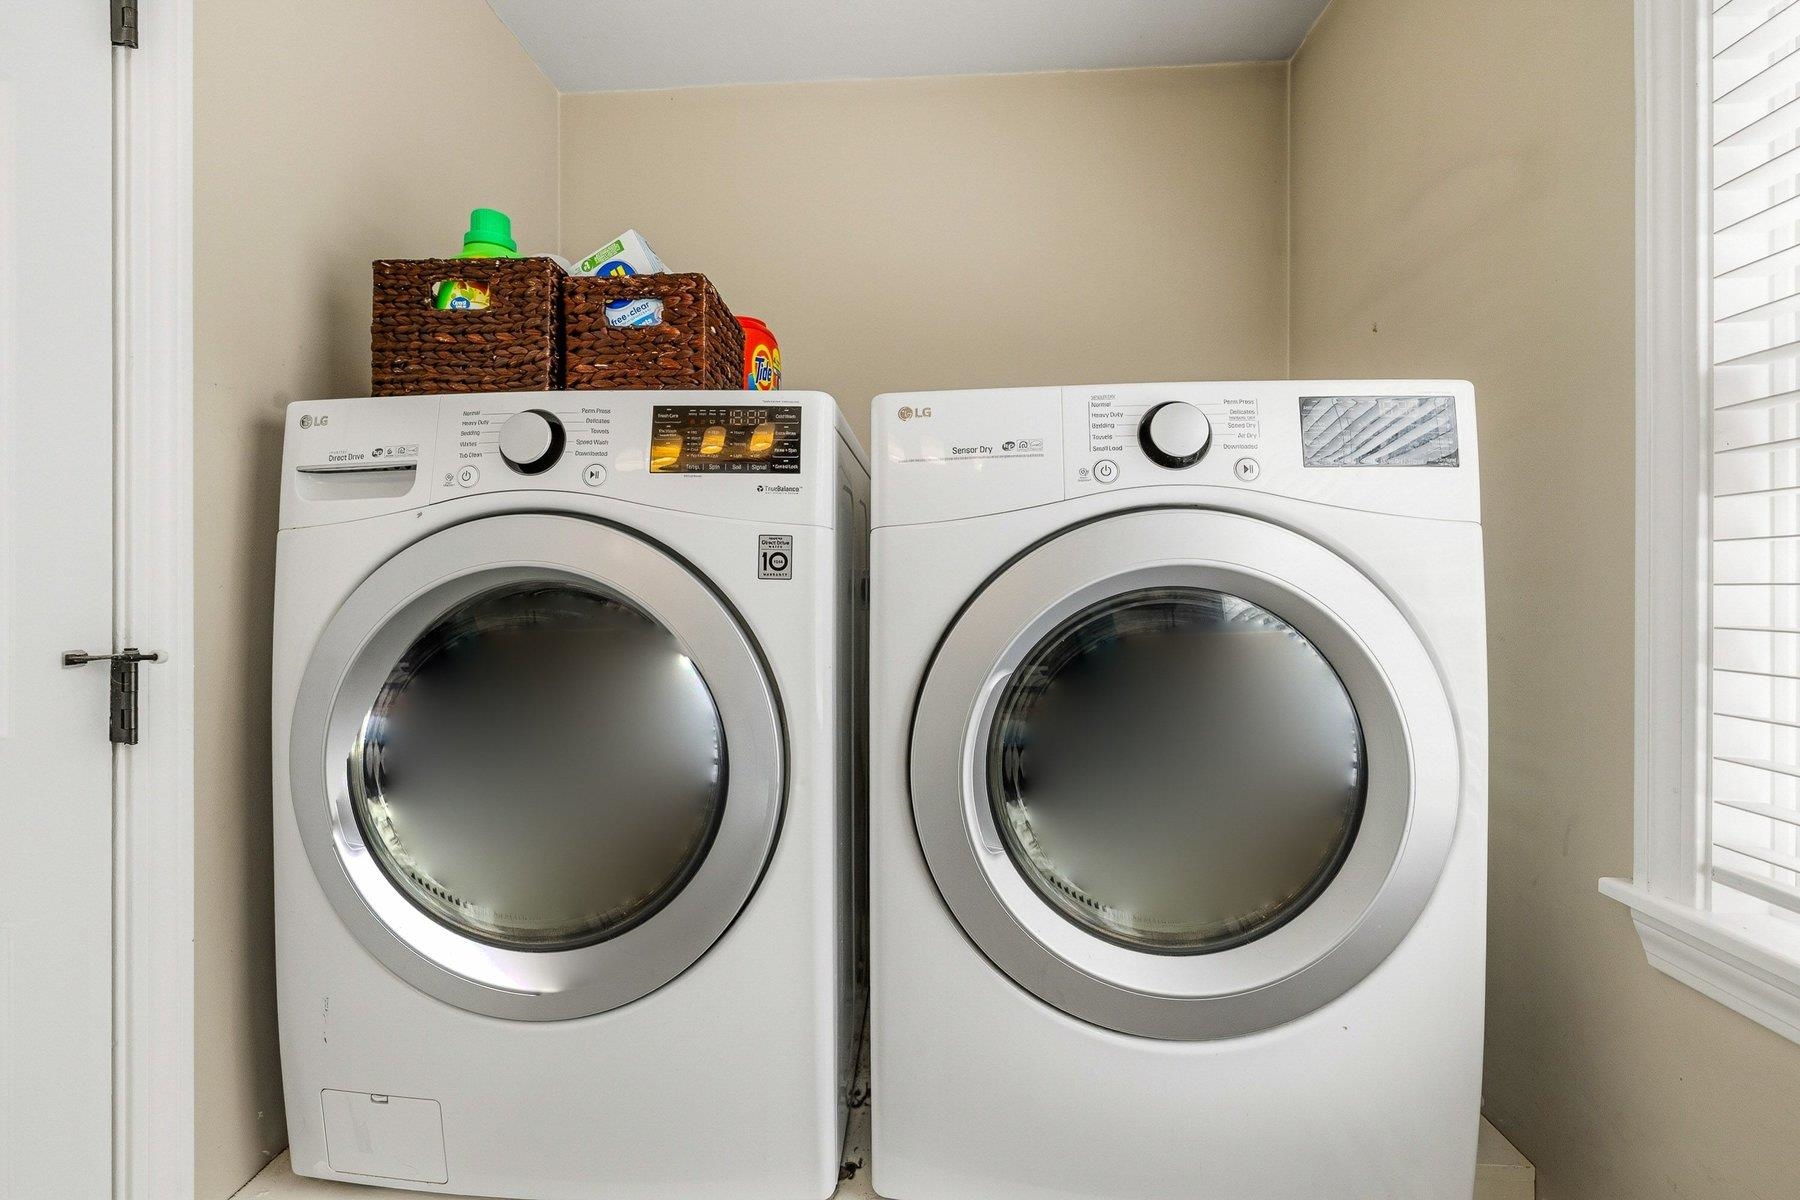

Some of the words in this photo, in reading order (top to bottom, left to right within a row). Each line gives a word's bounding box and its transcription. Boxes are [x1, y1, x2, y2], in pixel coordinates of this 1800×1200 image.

[611, 314, 627, 327] free
[630, 302, 650, 316] clear
[755, 357, 772, 383] Tide
[328, 454, 347, 462] Direct
[348, 453, 365, 461] Drive
[952, 446, 977, 455] Sensor
[980, 445, 993, 454] Dry
[762, 551, 788, 571] 10
